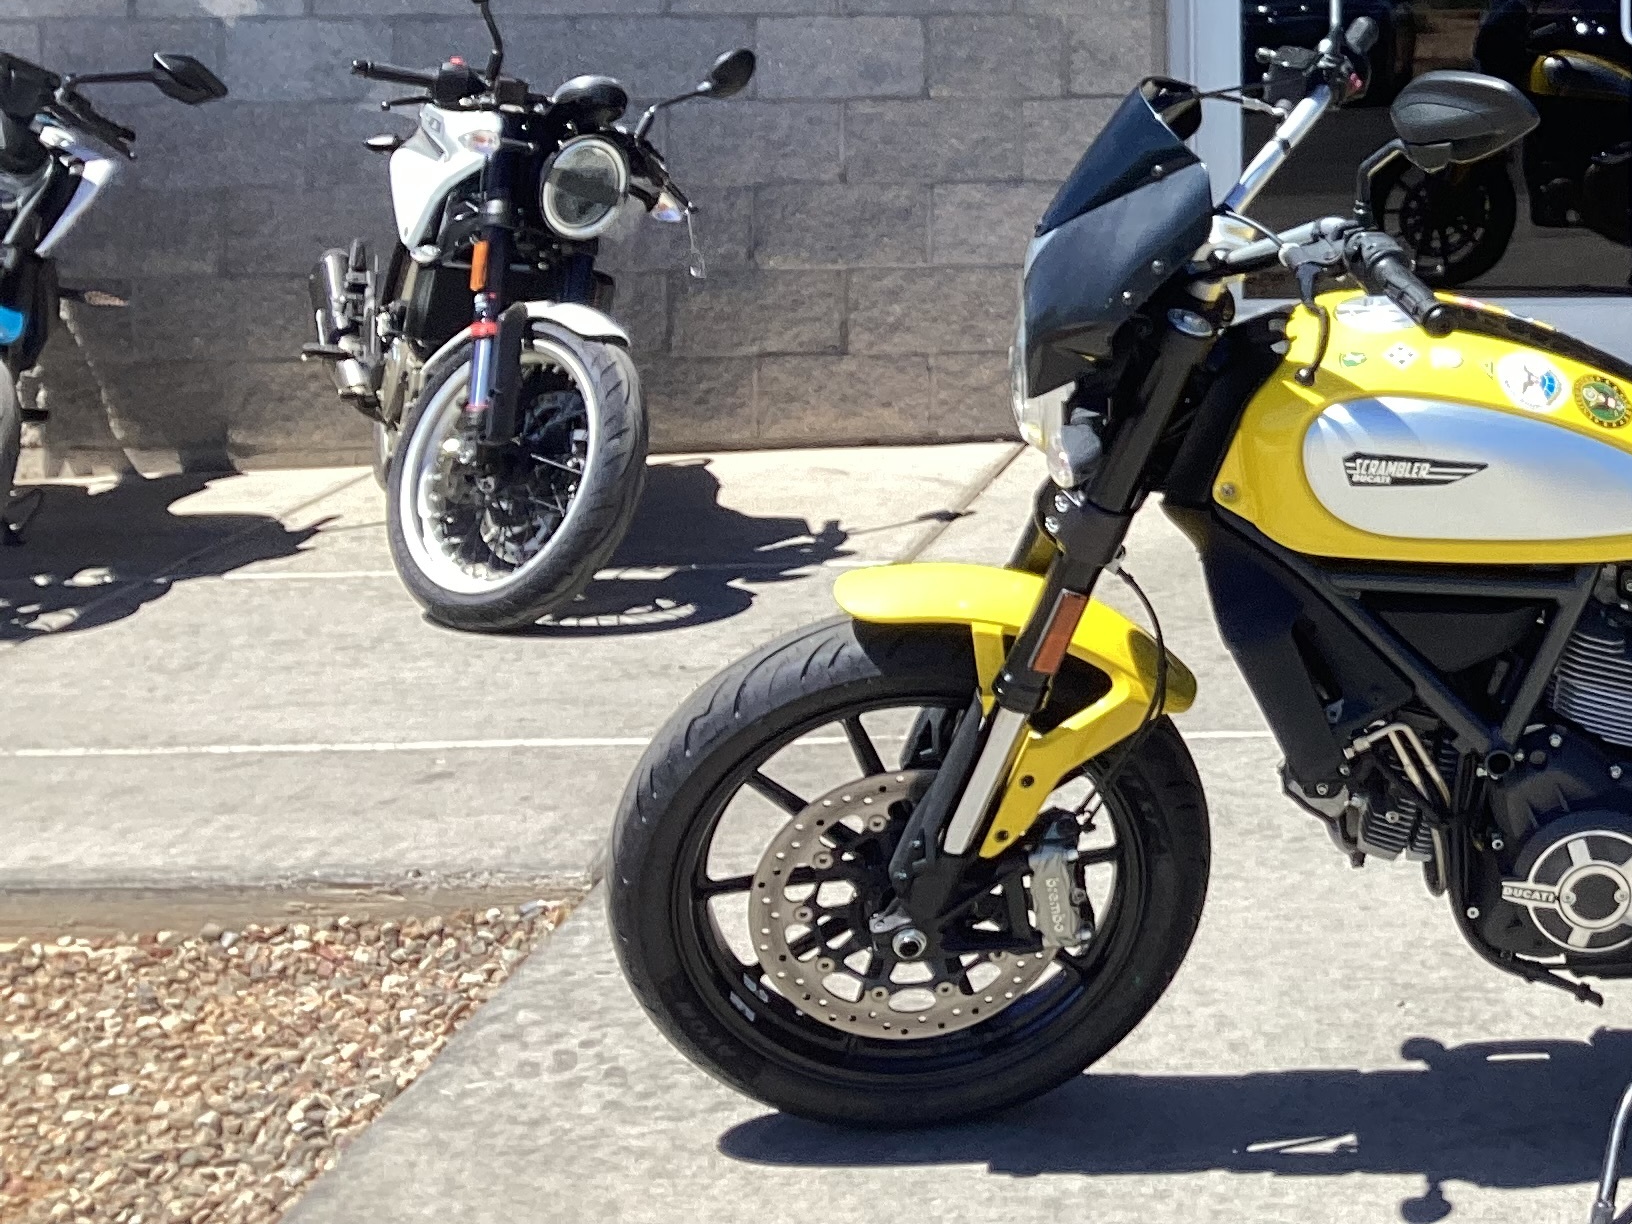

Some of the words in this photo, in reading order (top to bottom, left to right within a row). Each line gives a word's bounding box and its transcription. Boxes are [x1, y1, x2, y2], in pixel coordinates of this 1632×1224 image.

[1355, 458, 1431, 478] SCRAMBLER
[1502, 886, 1556, 902] DUCATI
[1045, 877, 1066, 933] brembo
